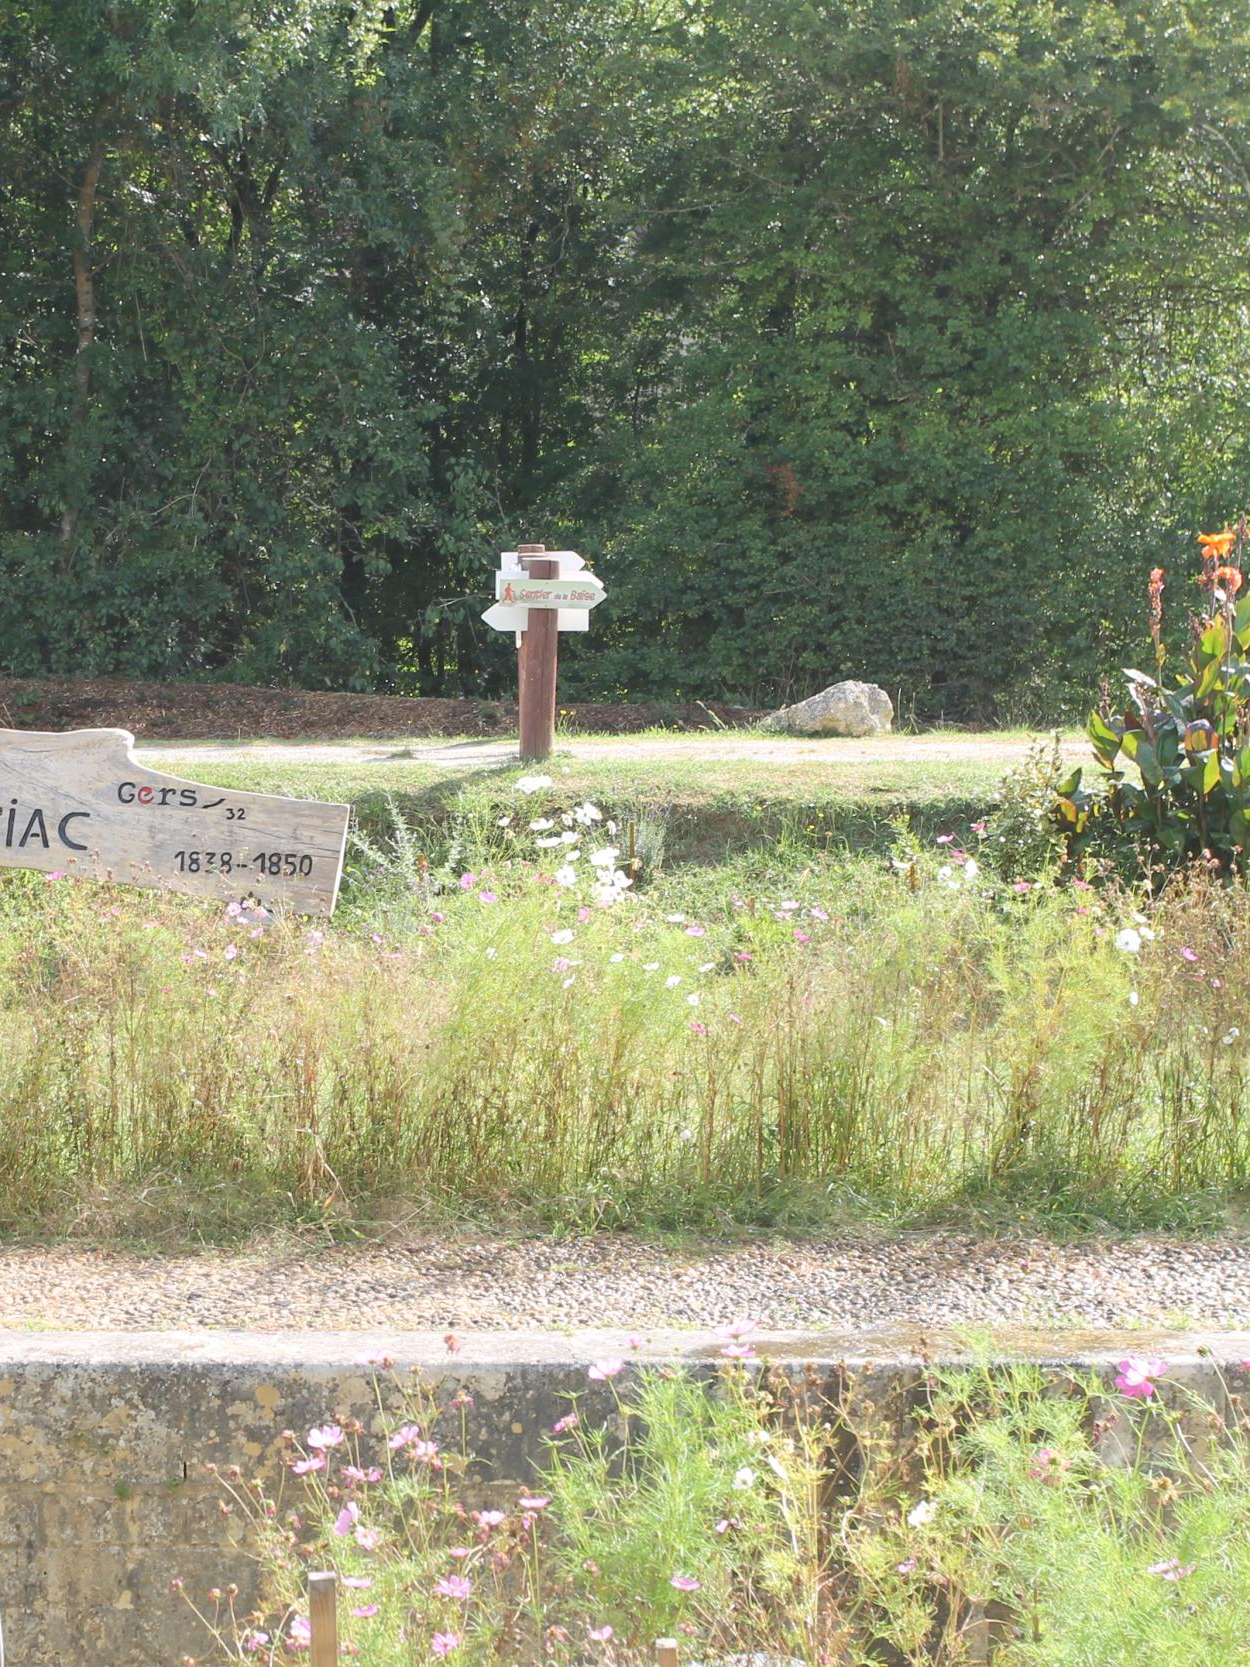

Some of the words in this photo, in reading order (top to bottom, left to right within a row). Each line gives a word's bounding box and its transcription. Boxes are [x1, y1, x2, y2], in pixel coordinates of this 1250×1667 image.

[519, 588, 551, 600] Sentier
[118, 782, 198, 806] Gers
[225, 808, 246, 820] 32
